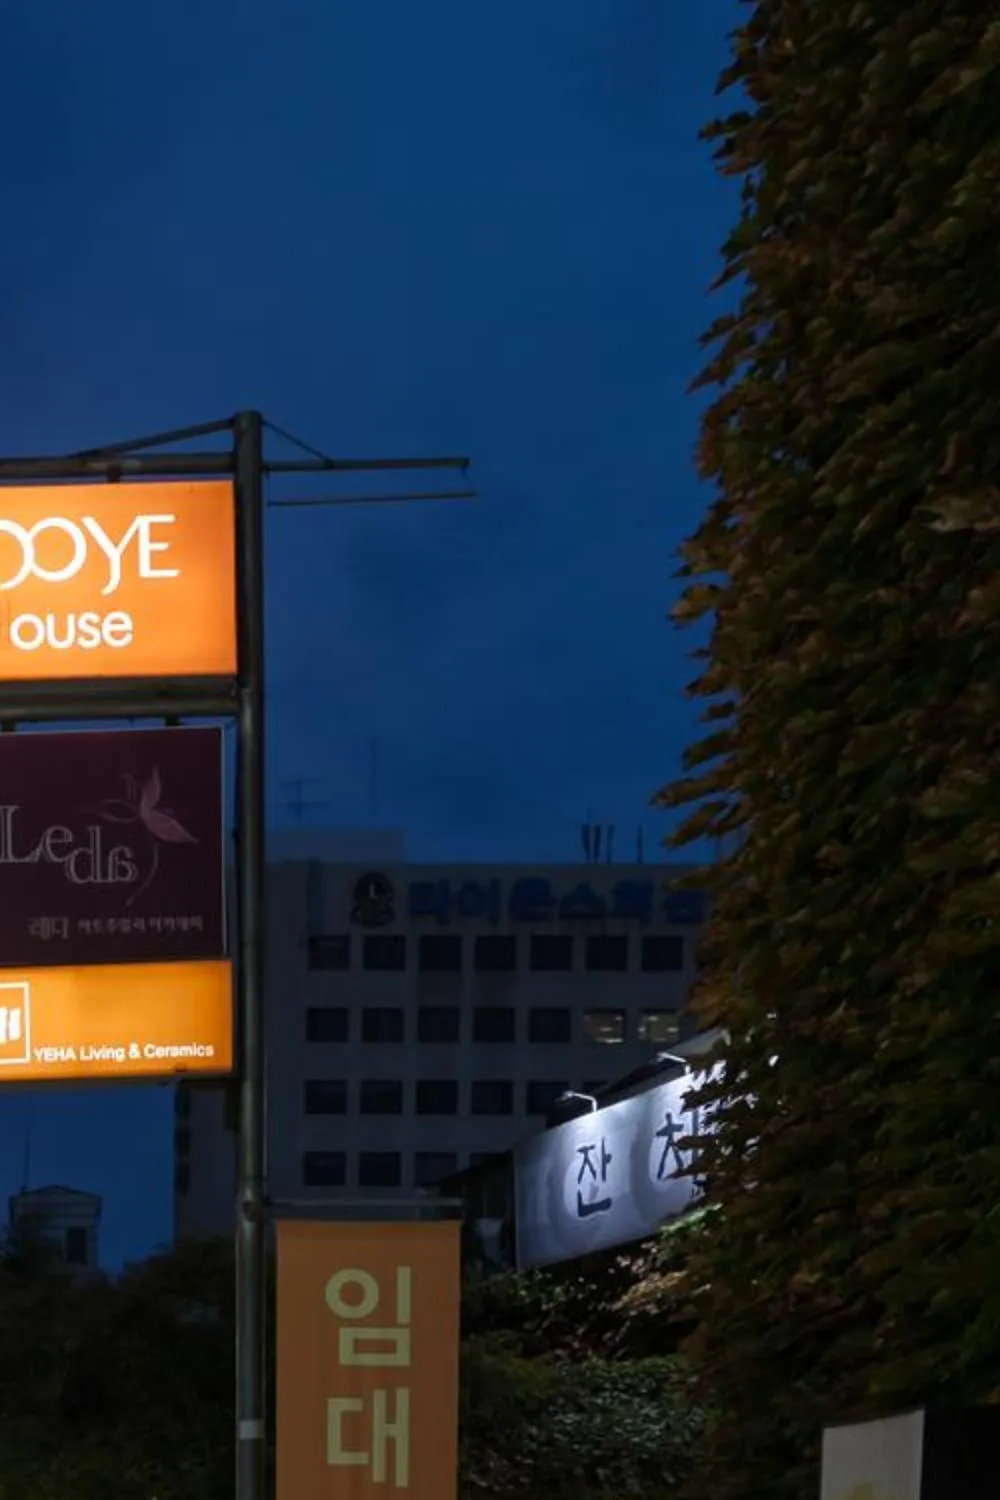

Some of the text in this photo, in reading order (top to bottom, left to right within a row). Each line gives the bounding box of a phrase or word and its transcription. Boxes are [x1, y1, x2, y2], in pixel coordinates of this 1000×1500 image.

[35, 1042, 215, 1062] YEHA Living & Ceramics
